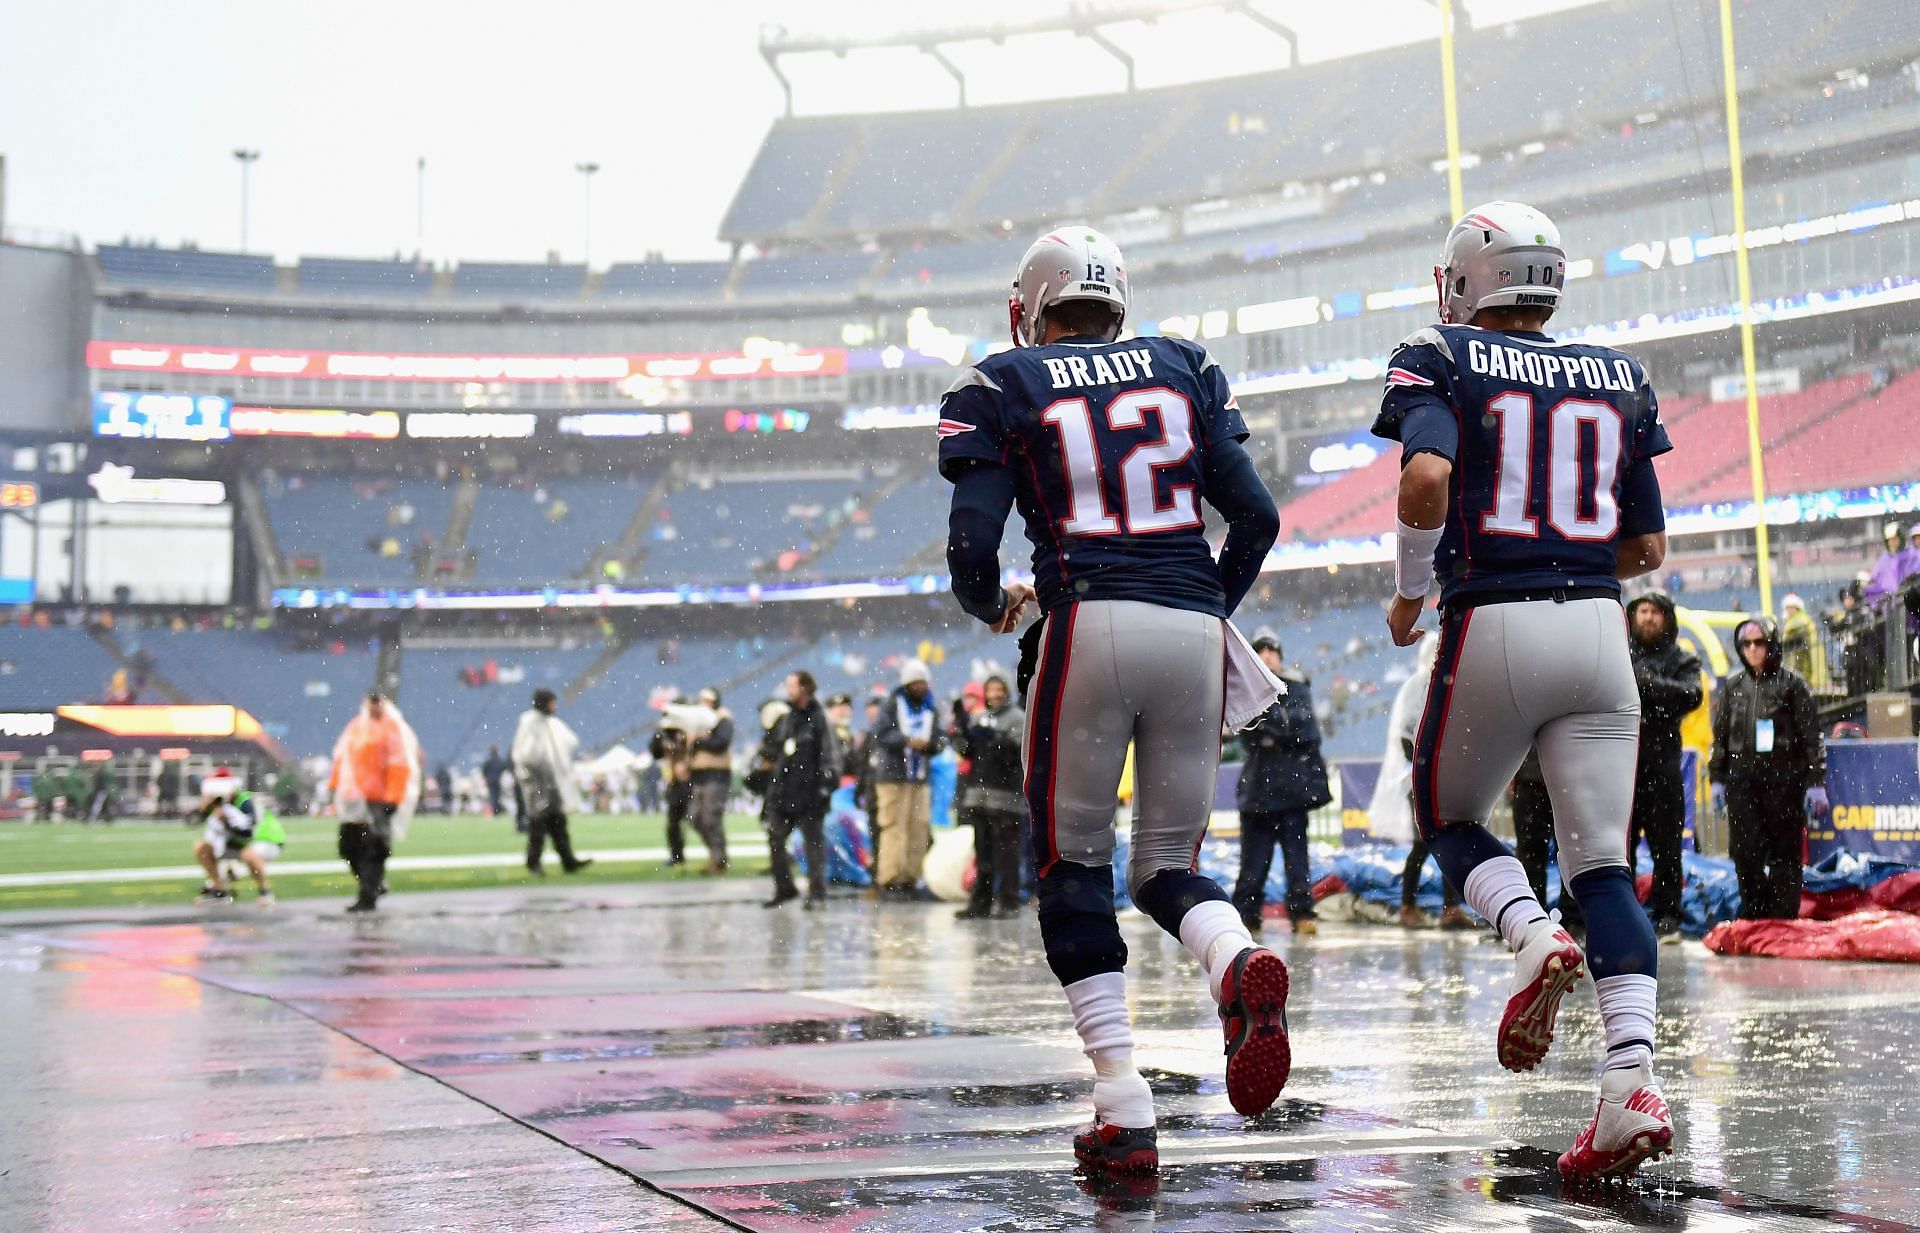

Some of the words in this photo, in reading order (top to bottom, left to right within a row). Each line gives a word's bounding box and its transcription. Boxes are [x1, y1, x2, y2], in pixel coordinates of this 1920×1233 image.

[1086, 264, 1105, 282] 12
[1526, 265, 1552, 284] 10
[1080, 283, 1110, 295] PATRIOTS
[1516, 293, 1557, 305] PATRIOTS
[1042, 348, 1154, 389] BRADY
[1468, 339, 1636, 393] GAROPPOLO
[1040, 386, 1201, 537] 12
[1479, 390, 1625, 542] 10
